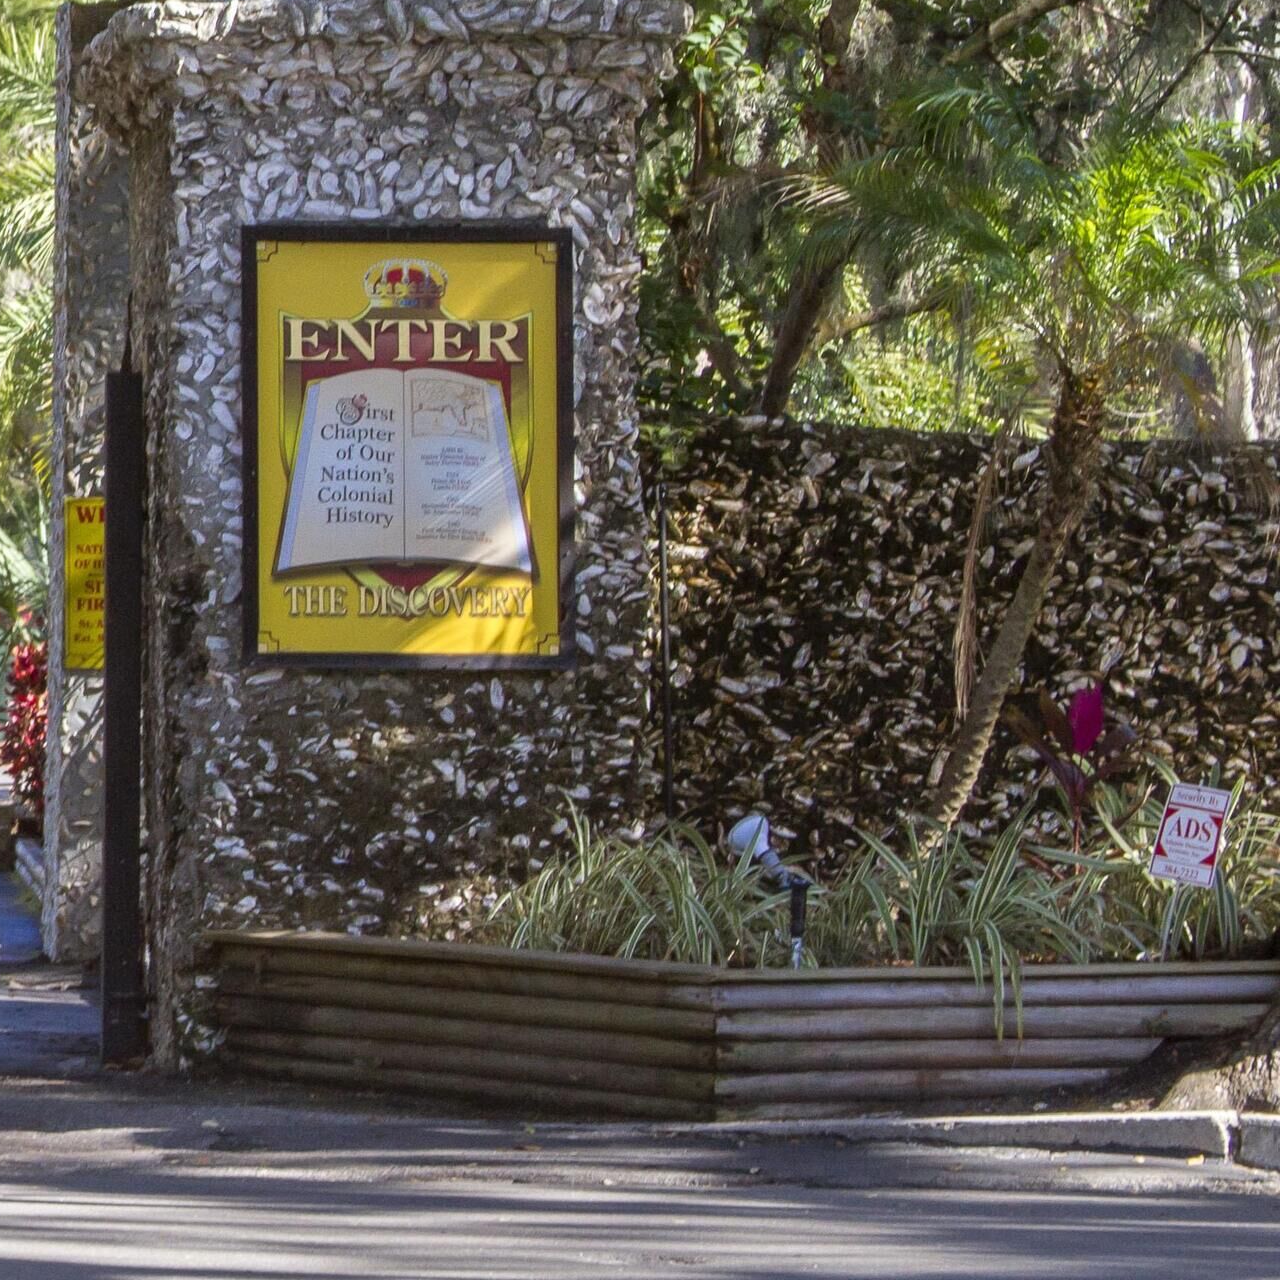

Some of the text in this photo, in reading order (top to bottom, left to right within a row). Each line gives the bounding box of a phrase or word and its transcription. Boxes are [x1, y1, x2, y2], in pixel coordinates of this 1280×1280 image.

[285, 319, 524, 363] ENTER
[335, 393, 394, 426] First
[320, 423, 395, 443] Chapter
[336, 443, 395, 463] of Our
[320, 465, 394, 484] Nation's
[318, 485, 393, 505] Colonial
[326, 506, 394, 528] History
[284, 583, 533, 618] THE DISCOVERY
[1168, 816, 1211, 842] ADS
